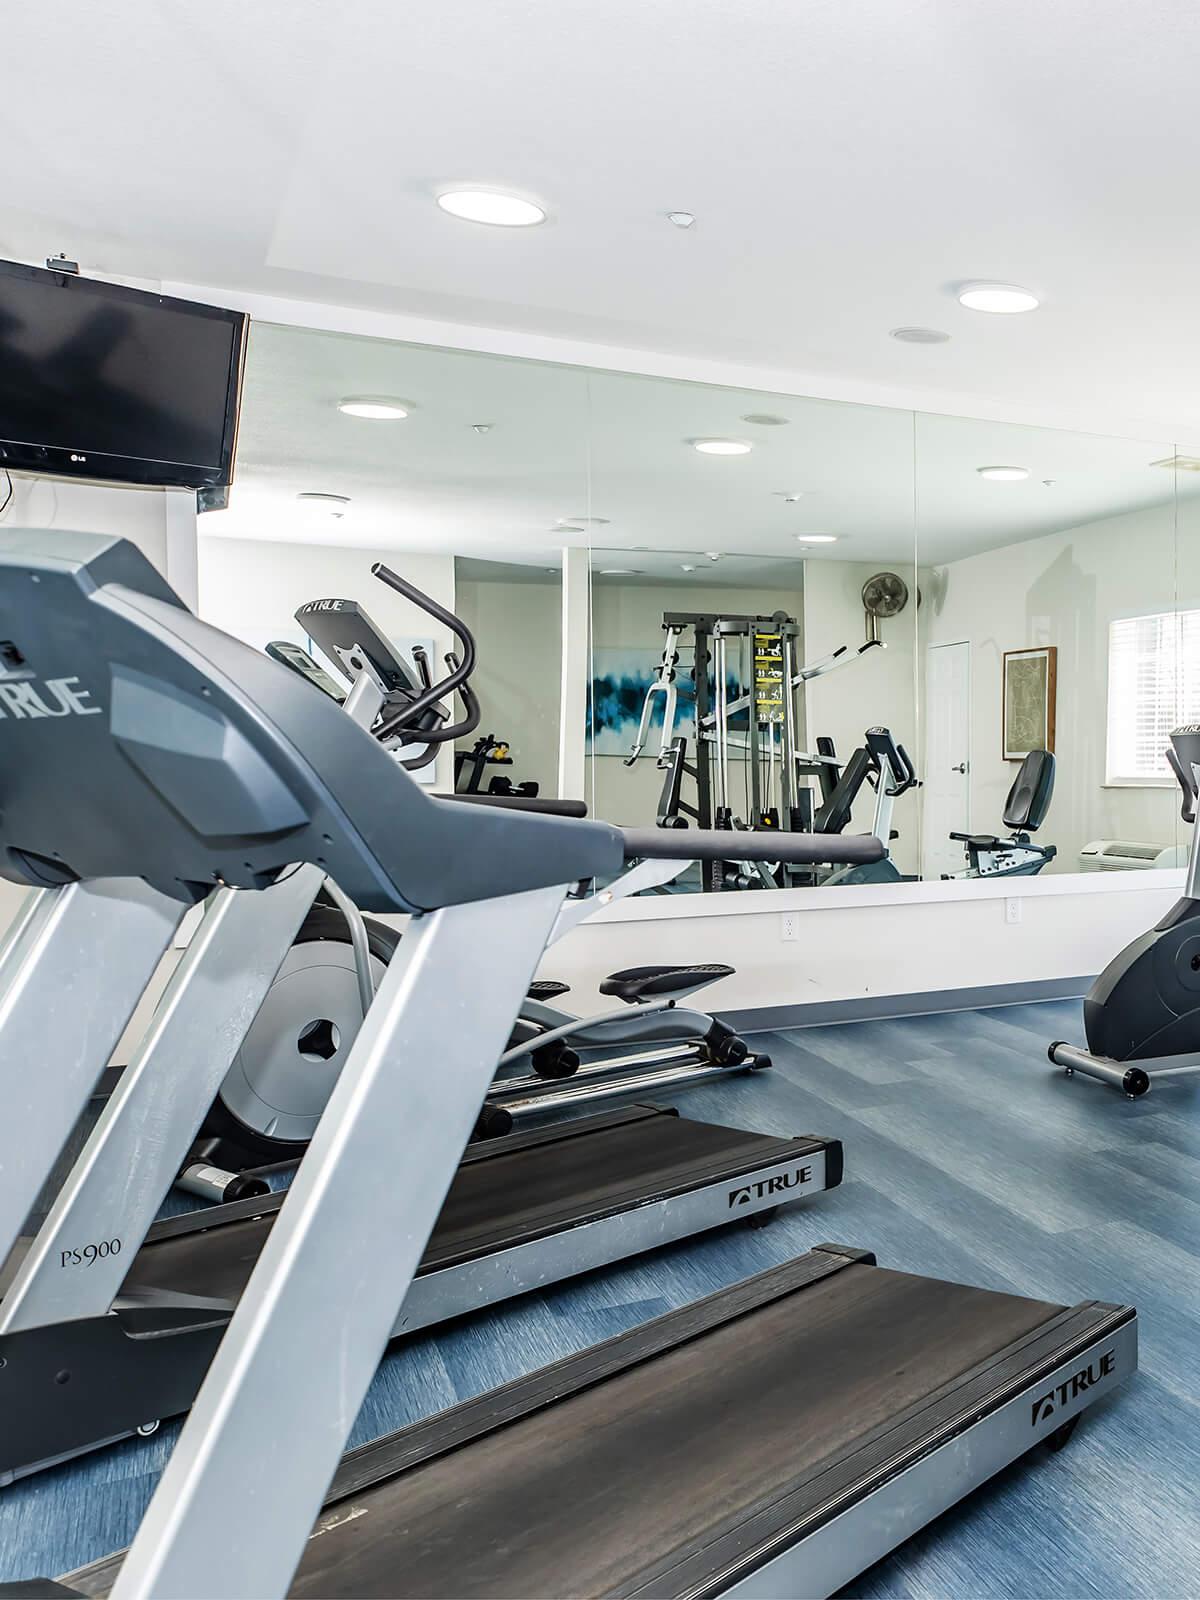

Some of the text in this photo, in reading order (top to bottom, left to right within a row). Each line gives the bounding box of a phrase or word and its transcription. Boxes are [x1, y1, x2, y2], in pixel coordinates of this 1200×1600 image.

[312, 600, 344, 611] TRUE
[0, 676, 103, 719] RUE
[751, 1165, 812, 1198] TRUE
[61, 1238, 121, 1267] PS900
[1056, 1349, 1115, 1407] TRUE
